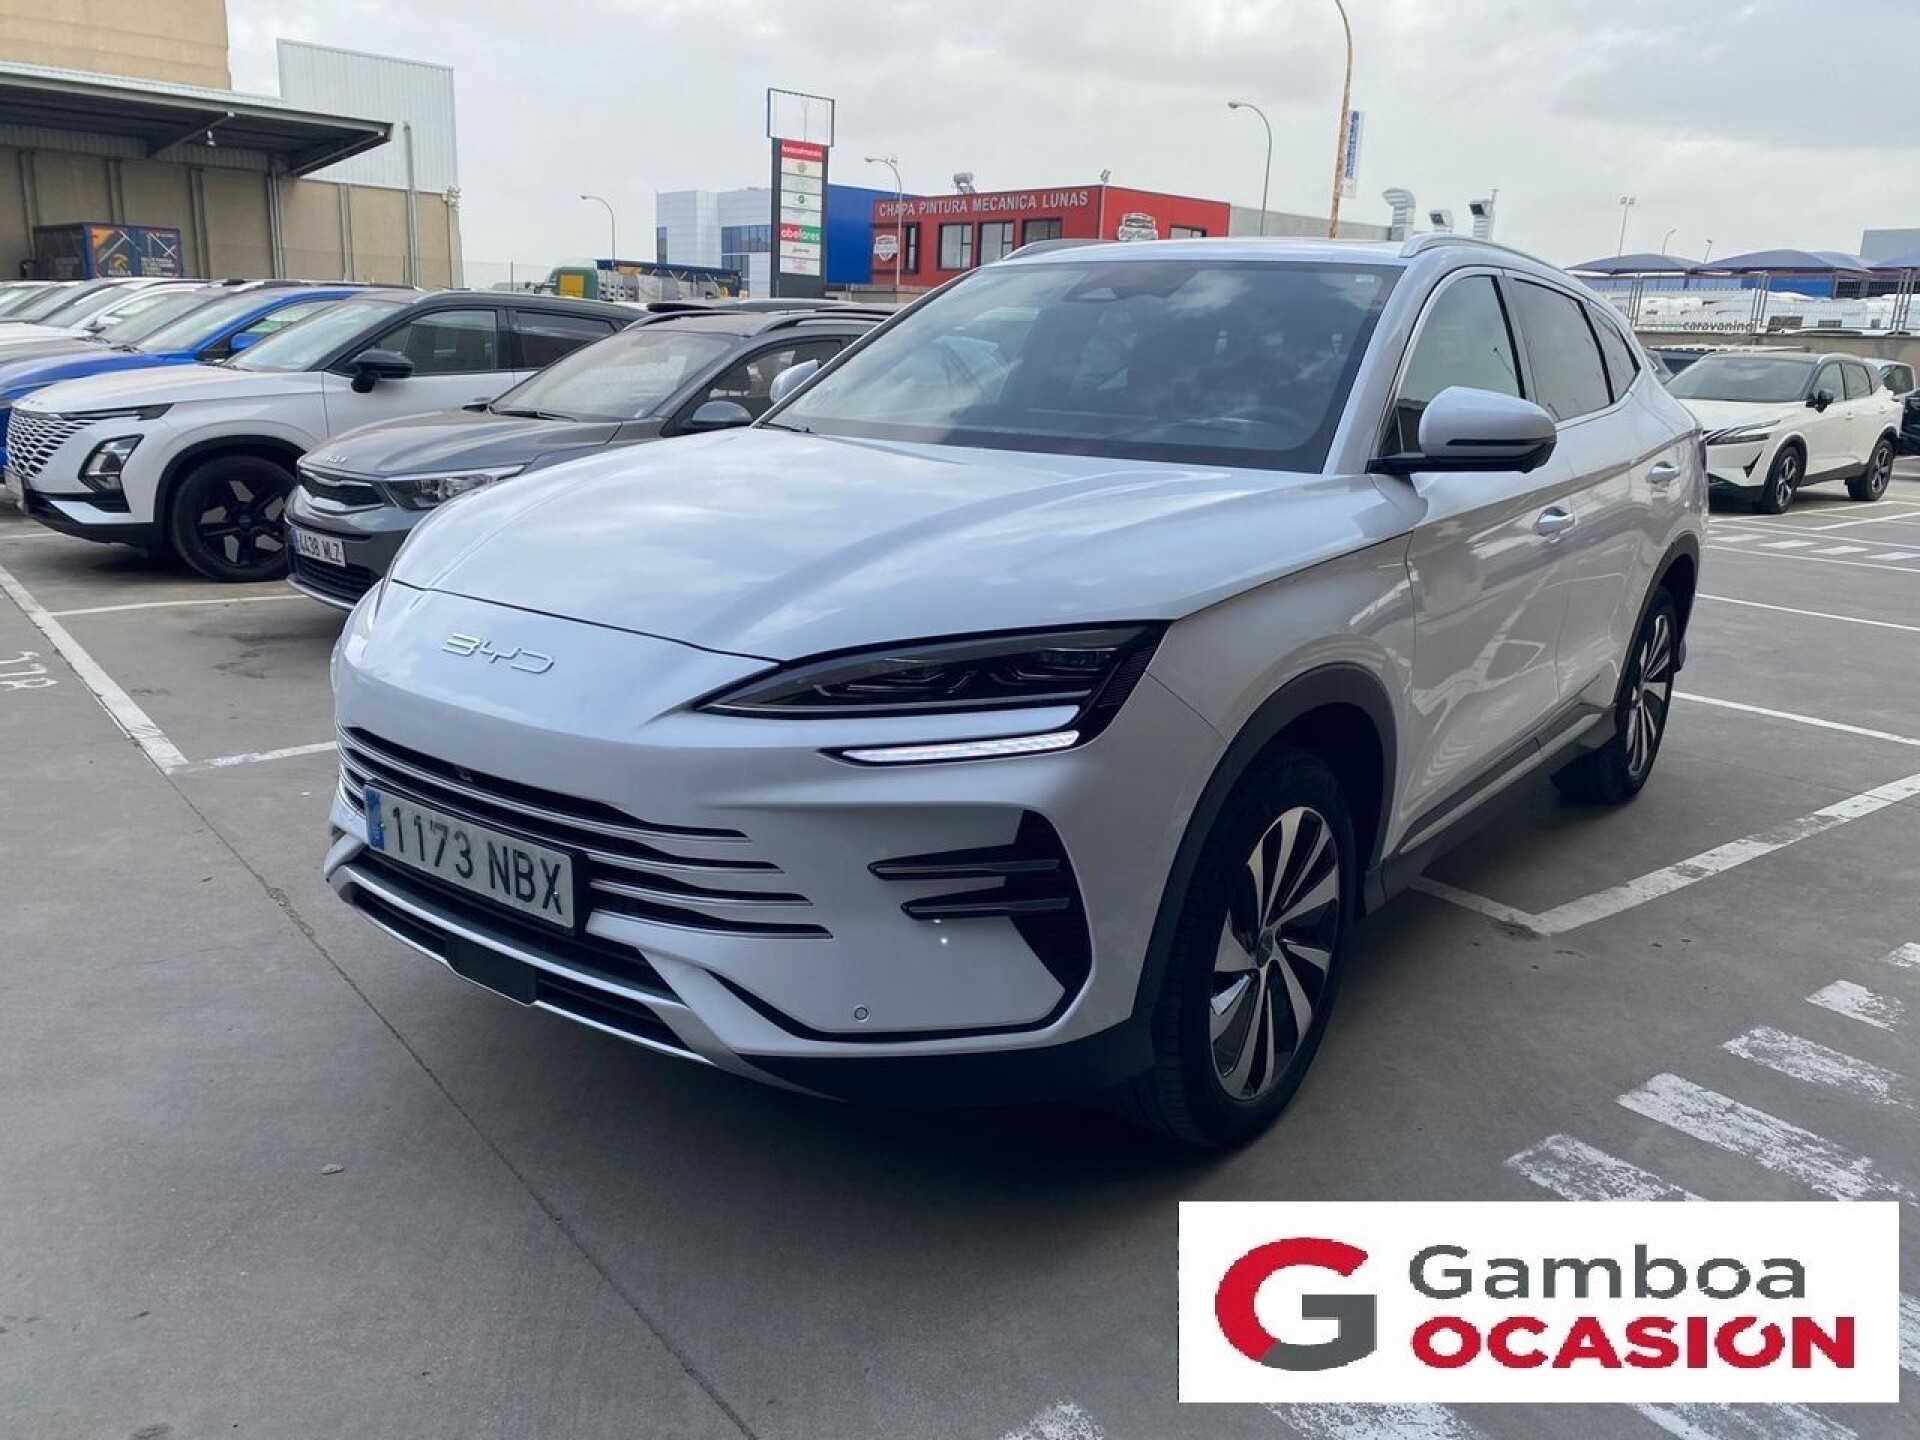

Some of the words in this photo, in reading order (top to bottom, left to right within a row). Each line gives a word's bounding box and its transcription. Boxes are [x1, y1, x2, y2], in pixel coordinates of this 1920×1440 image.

[879, 203, 915, 217] CHAPA
[919, 200, 968, 214] PINTURA
[973, 194, 1037, 212] MECANICA
[1042, 191, 1088, 208] LUNAS
[441, 632, 554, 675] BYD
[392, 806, 474, 880] 1173
[487, 840, 563, 916] NBX
